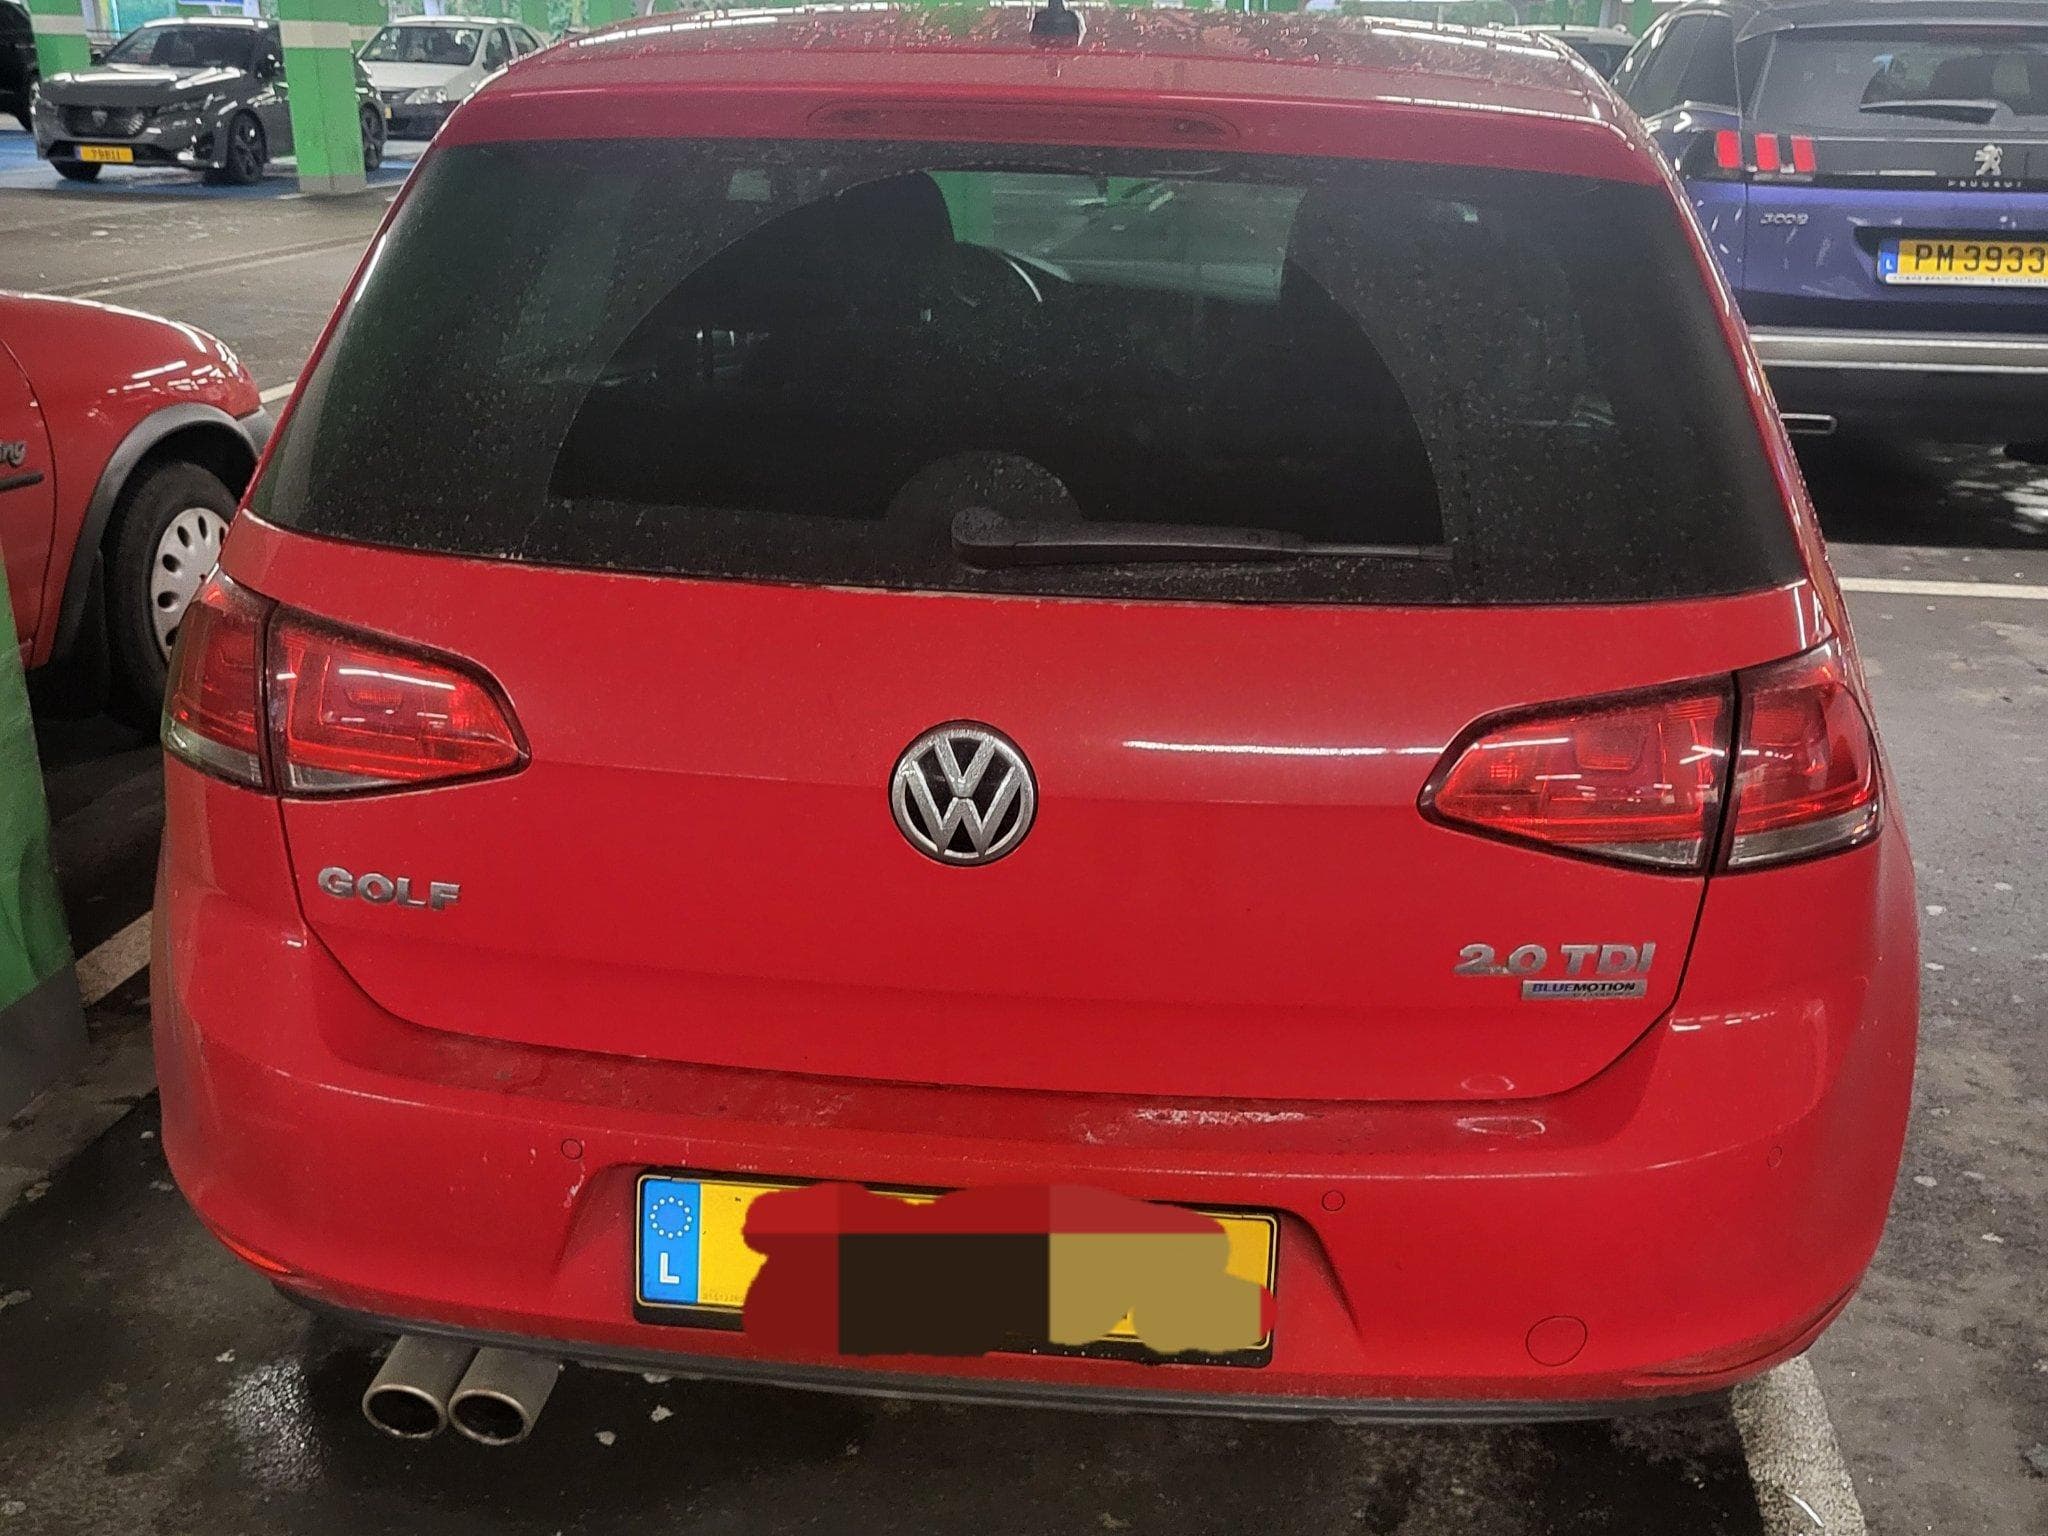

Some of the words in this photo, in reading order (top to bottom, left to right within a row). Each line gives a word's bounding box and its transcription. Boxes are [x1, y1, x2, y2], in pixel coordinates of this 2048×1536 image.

[317, 866, 461, 911] GOLF
[1454, 942, 1548, 976] 2.0
[1560, 942, 1657, 975] TDI
[1532, 982, 1636, 993] BLUEMOTION
[659, 1251, 680, 1285] L
